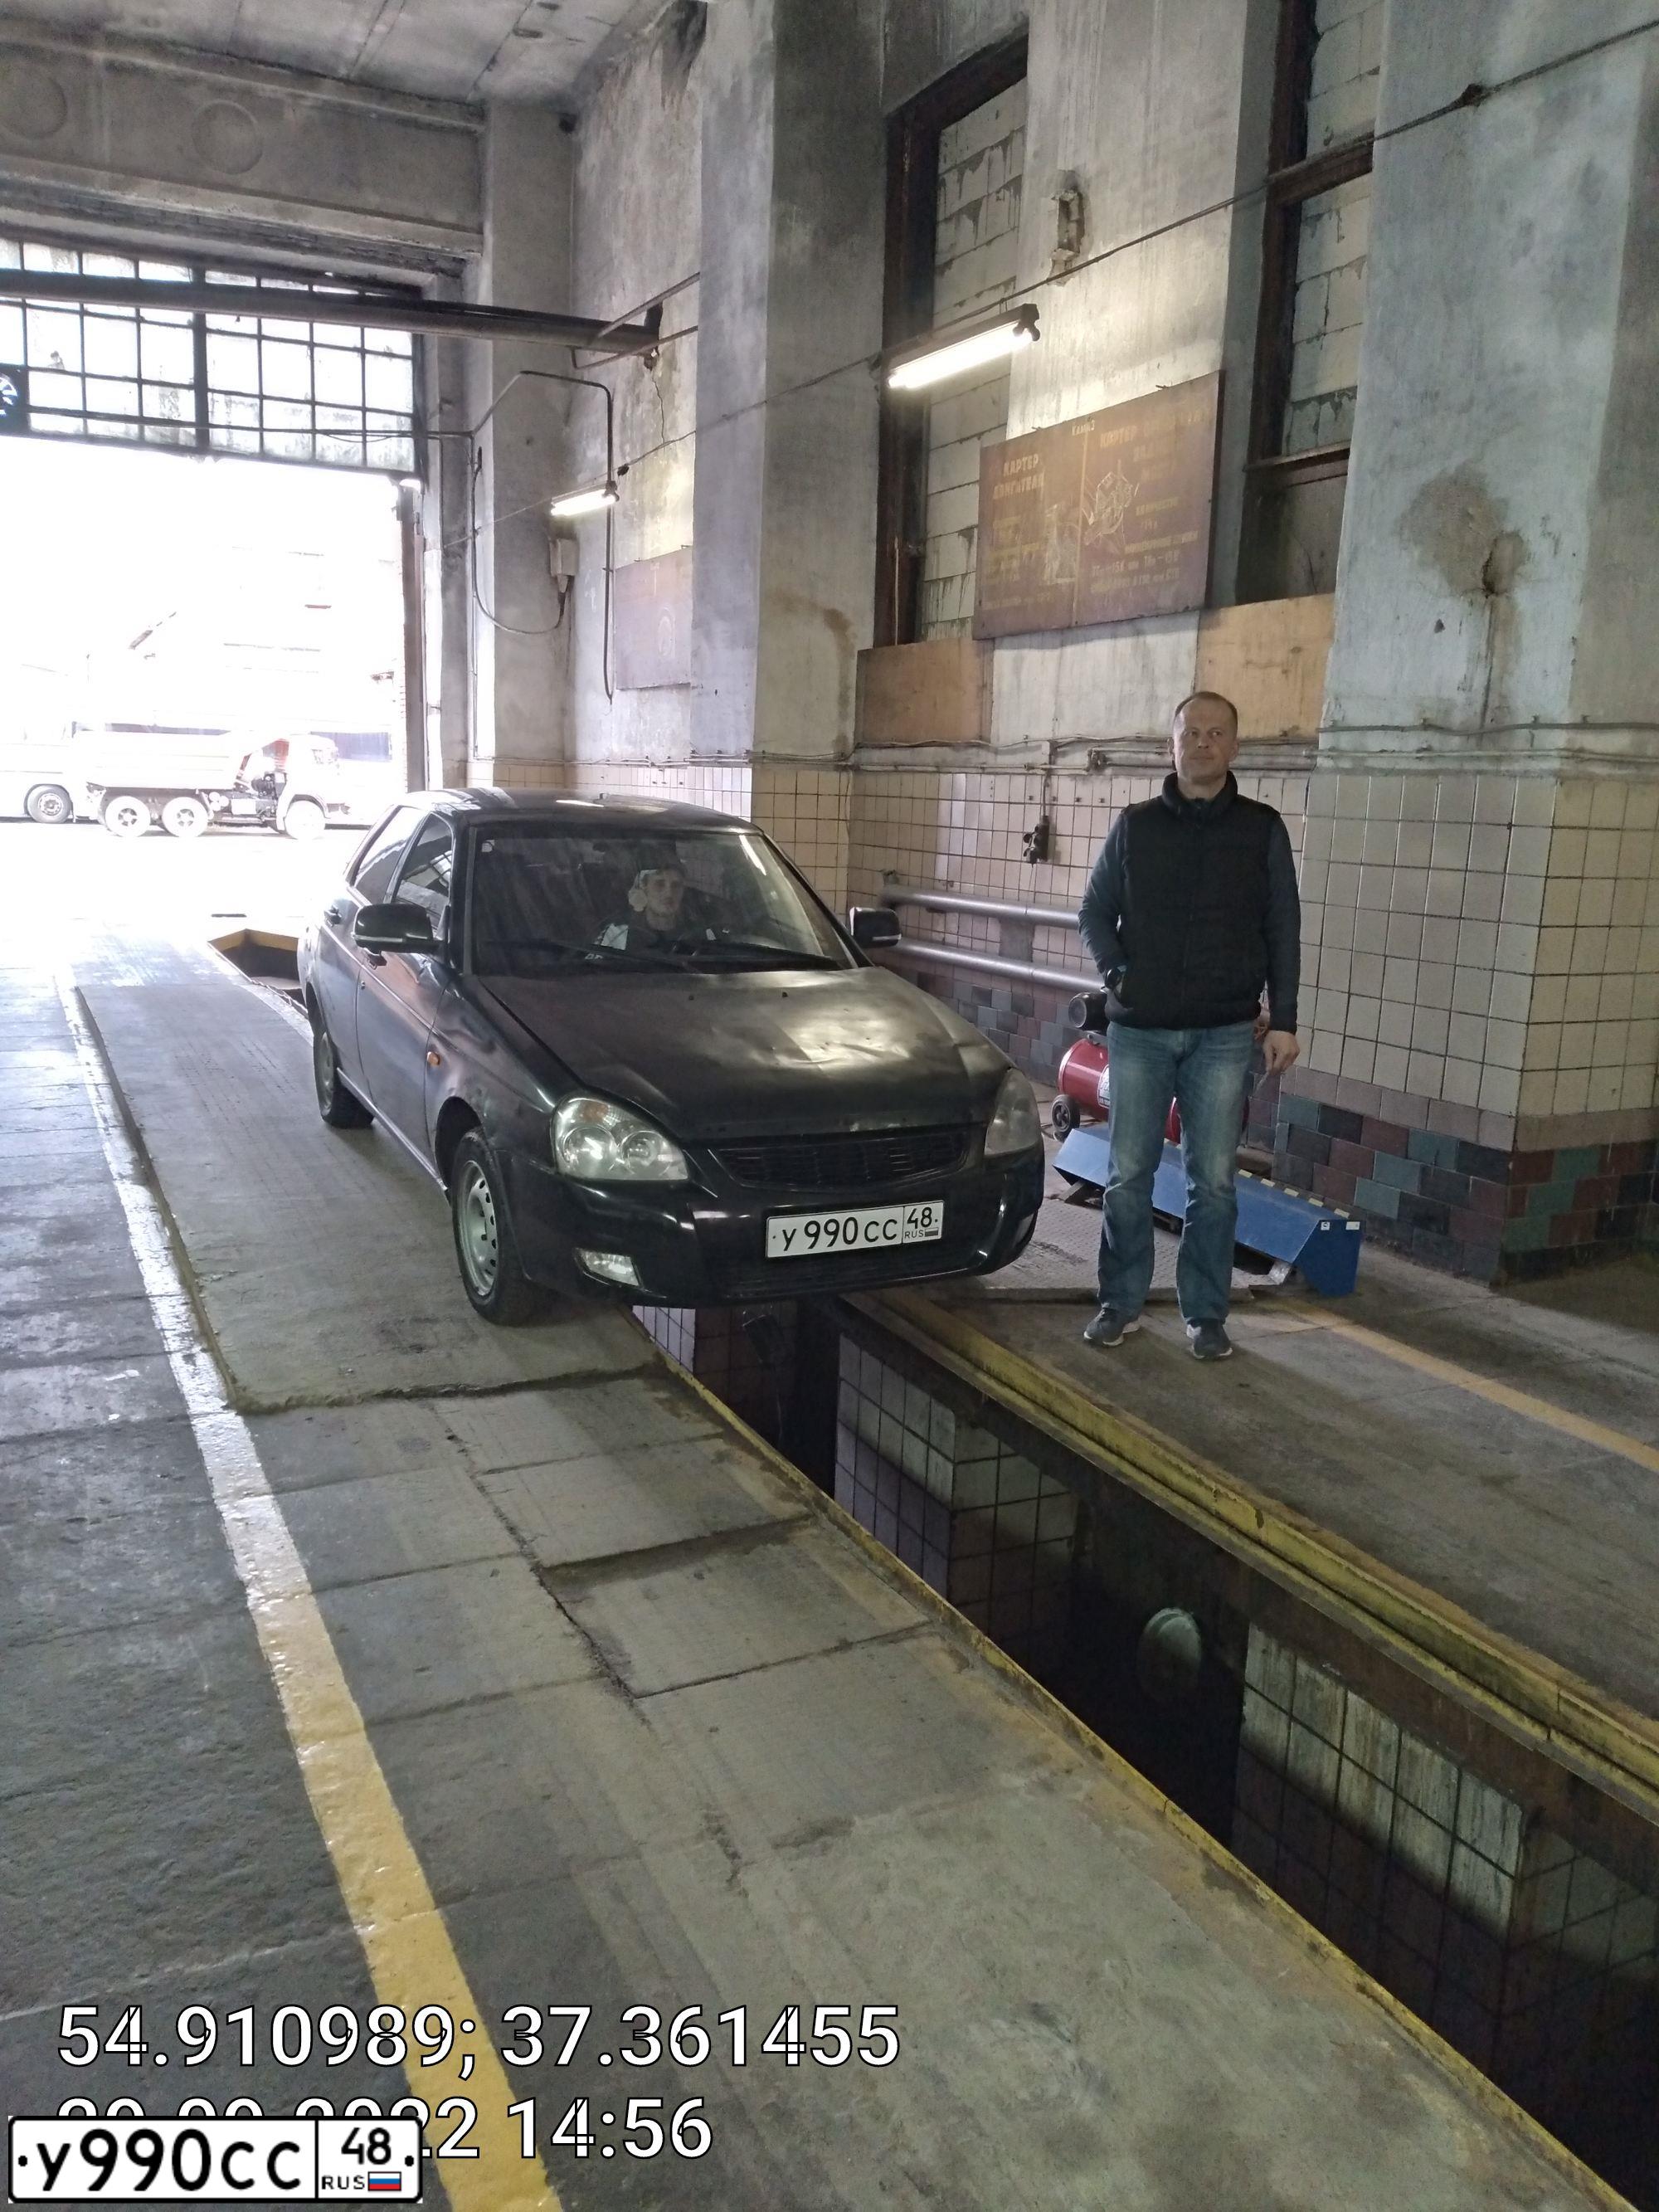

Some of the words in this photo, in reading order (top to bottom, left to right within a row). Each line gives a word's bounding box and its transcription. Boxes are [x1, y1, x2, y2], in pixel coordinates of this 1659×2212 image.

[1003, 453, 1039, 477] КАРТЕР
[907, 1207, 932, 1229] 48
[904, 1230, 923, 1239] RUS
